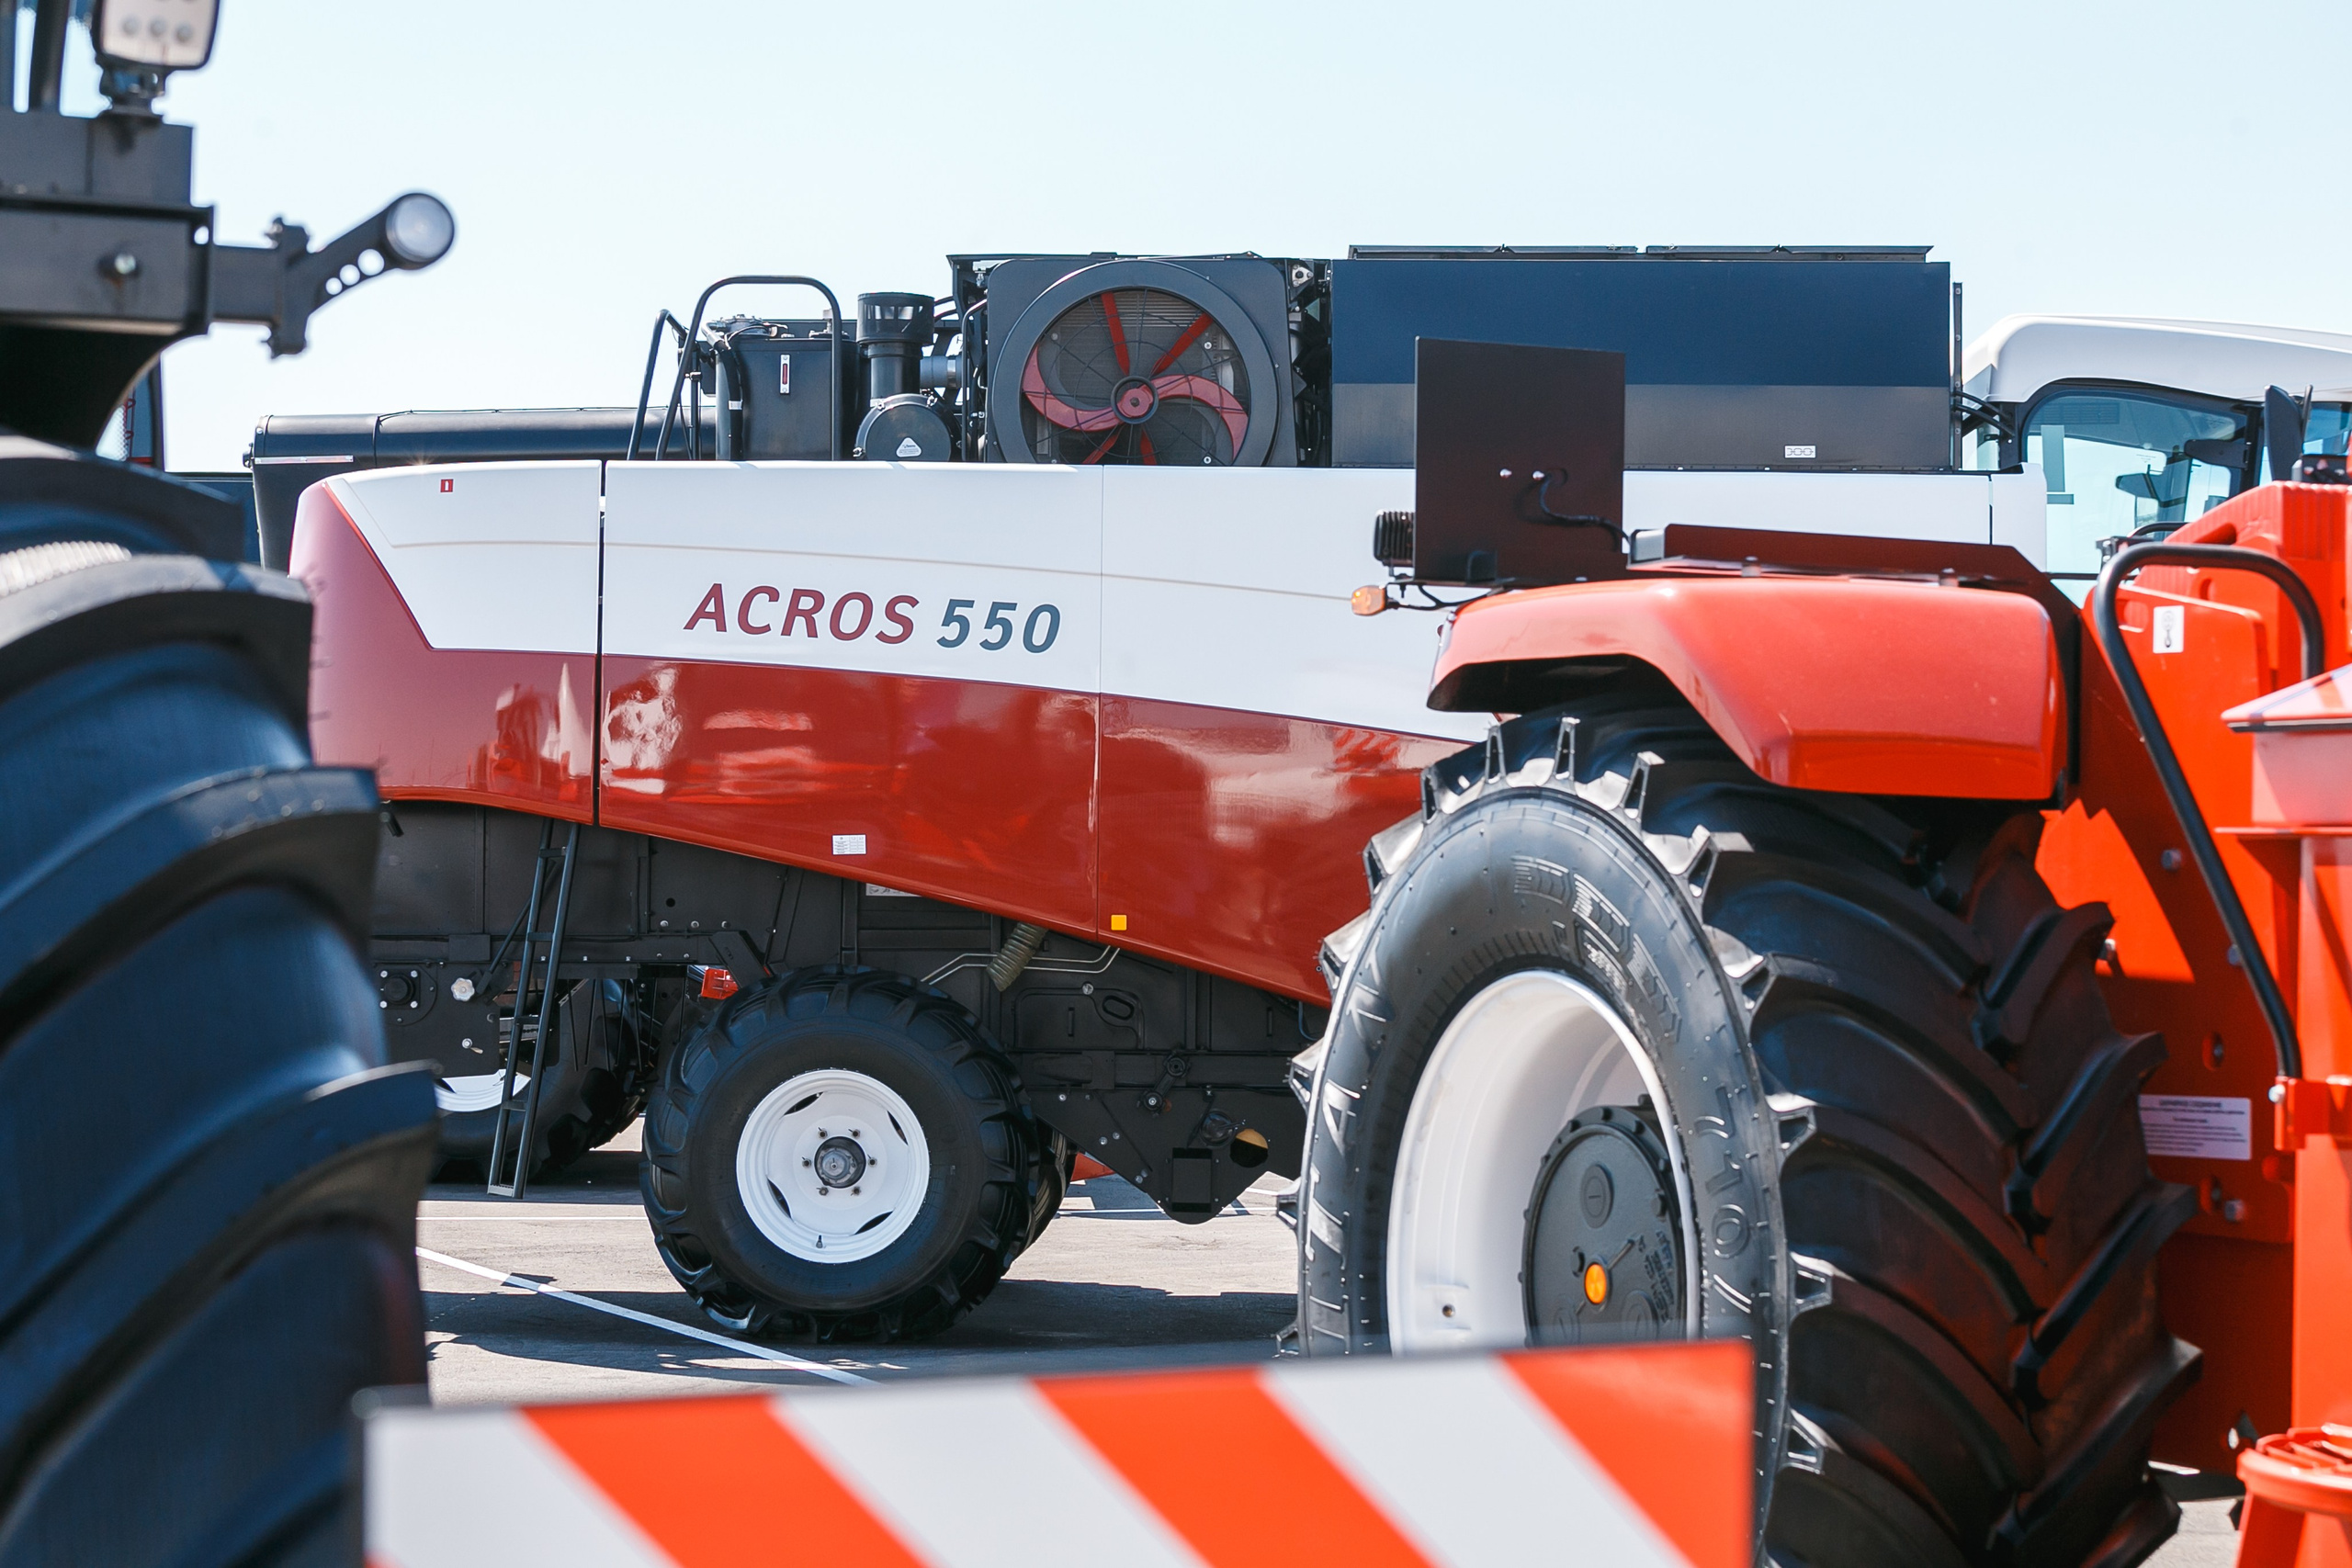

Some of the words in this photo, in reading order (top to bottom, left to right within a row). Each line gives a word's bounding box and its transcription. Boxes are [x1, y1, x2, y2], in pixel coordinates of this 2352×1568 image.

[683, 582, 920, 645] ACROS
[935, 598, 1062, 653] 550
[1304, 933, 1395, 1355] ITAN
[1694, 1084, 1753, 1338] 710/
